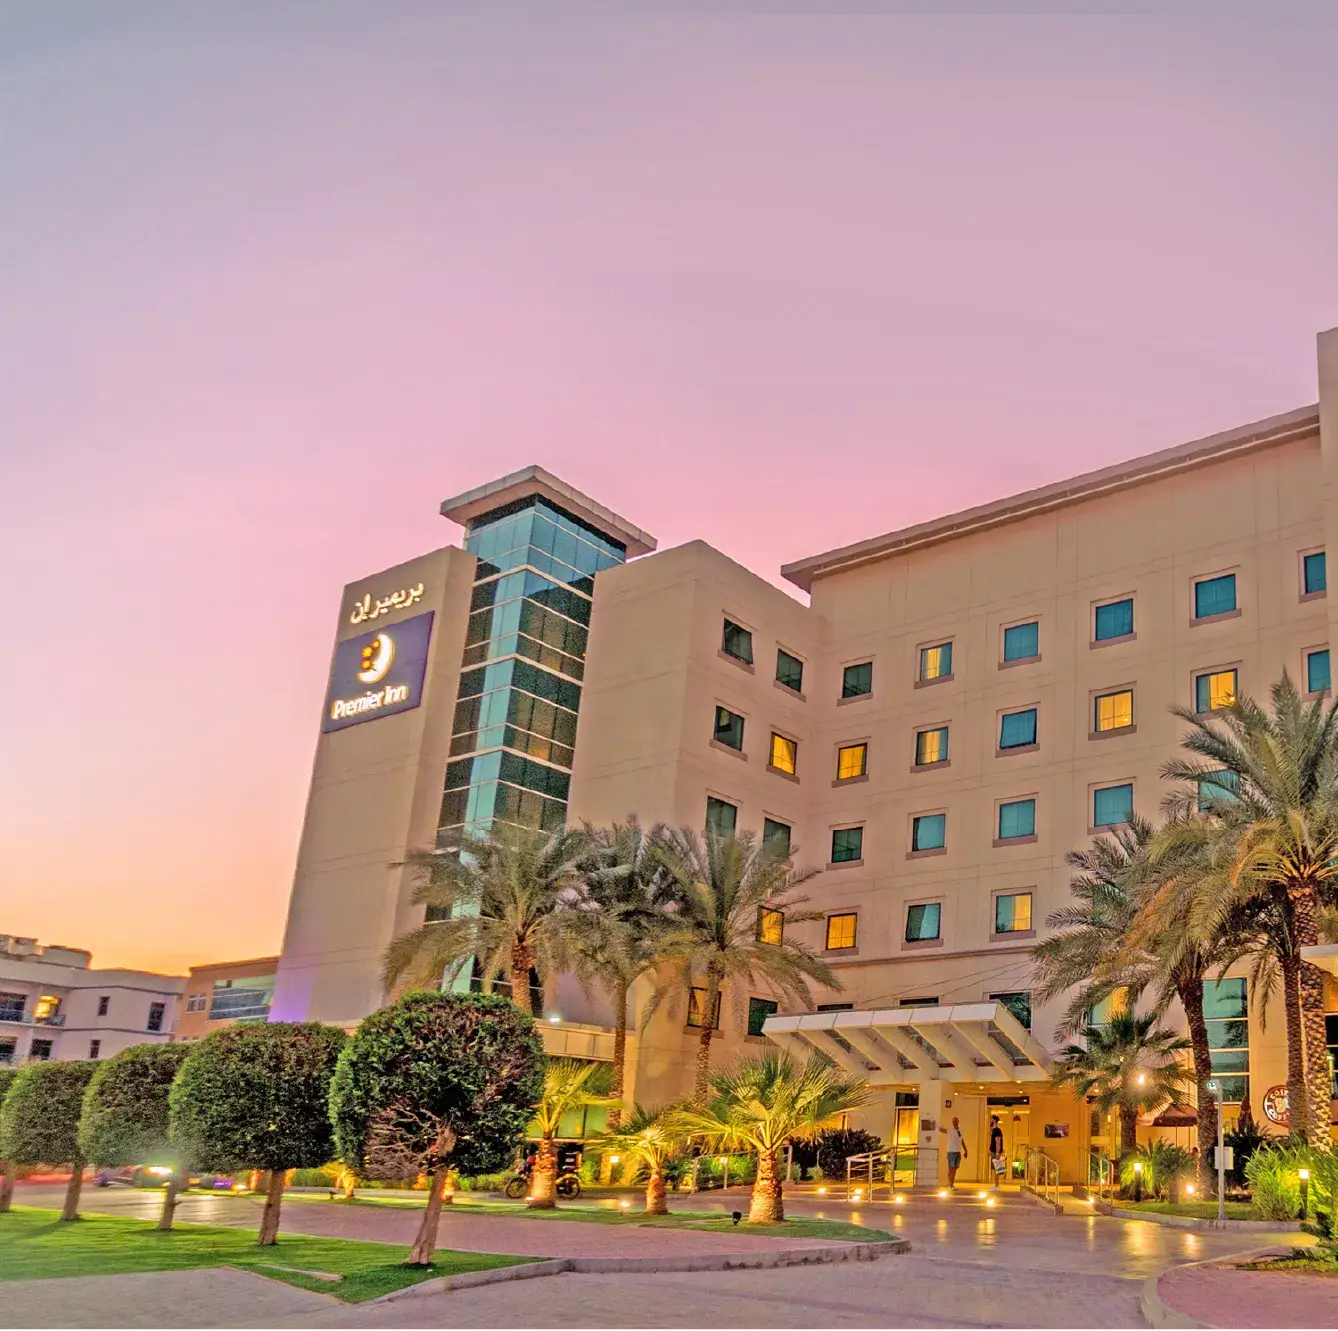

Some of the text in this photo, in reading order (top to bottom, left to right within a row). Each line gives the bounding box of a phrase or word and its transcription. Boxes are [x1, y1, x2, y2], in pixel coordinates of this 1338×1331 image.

[369, 583, 424, 618] بريمير
[331, 685, 408, 720] Premier Inn
